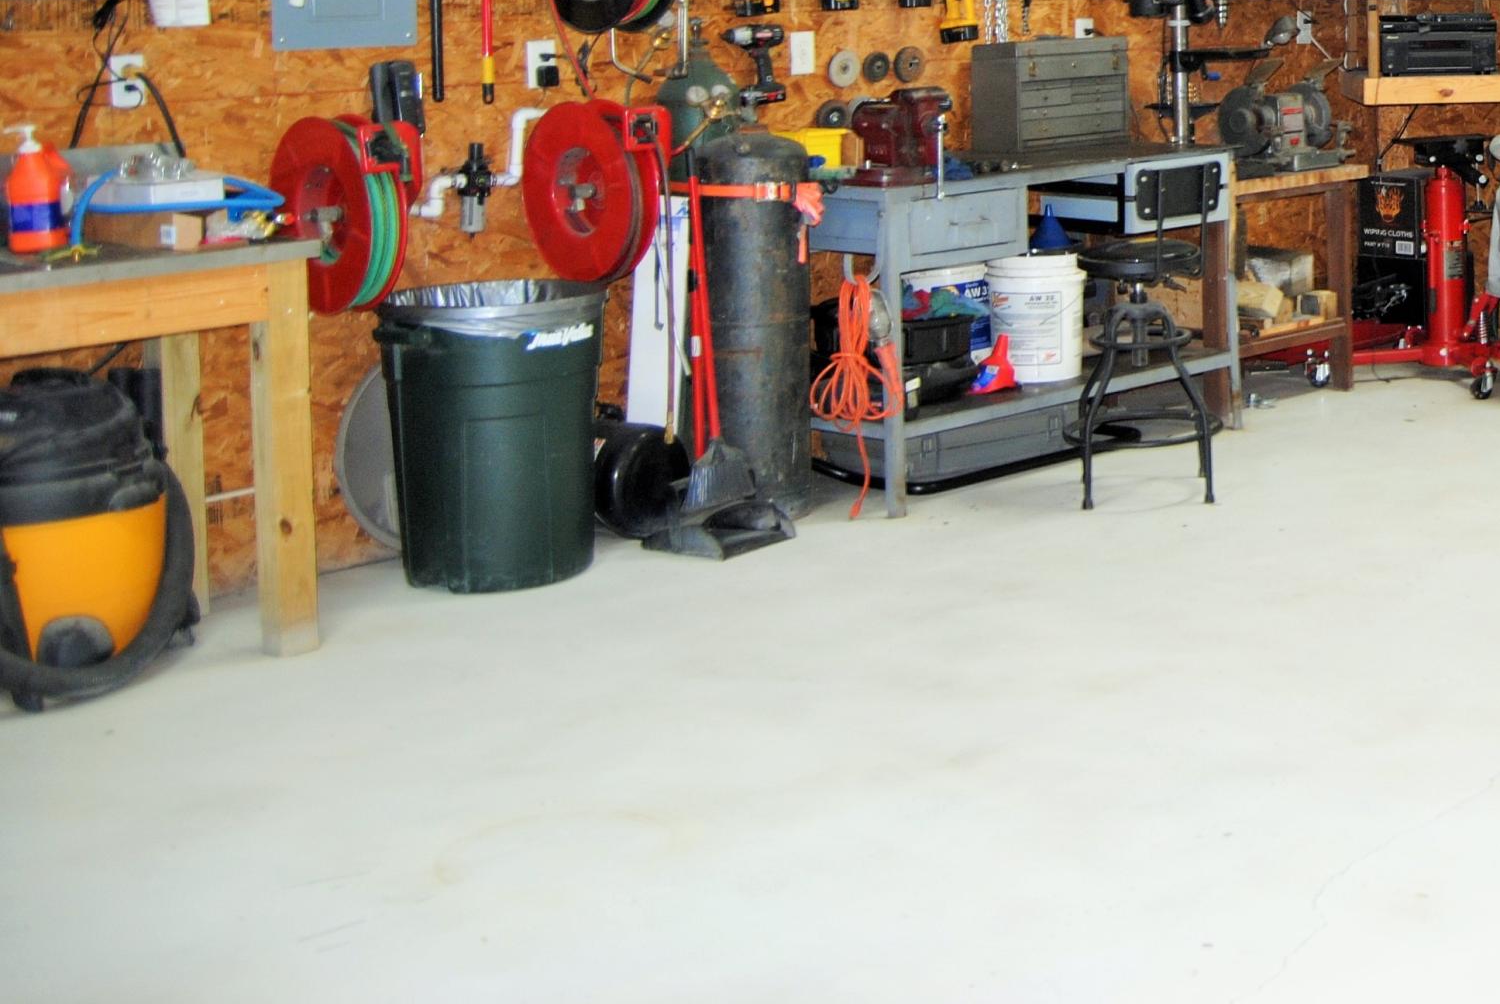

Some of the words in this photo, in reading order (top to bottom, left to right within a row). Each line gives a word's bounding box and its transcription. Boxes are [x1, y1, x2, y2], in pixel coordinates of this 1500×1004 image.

[1363, 227, 1387, 237] WIPING
[1387, 229, 1413, 238] CLOTHS
[963, 287, 981, 299] AW
